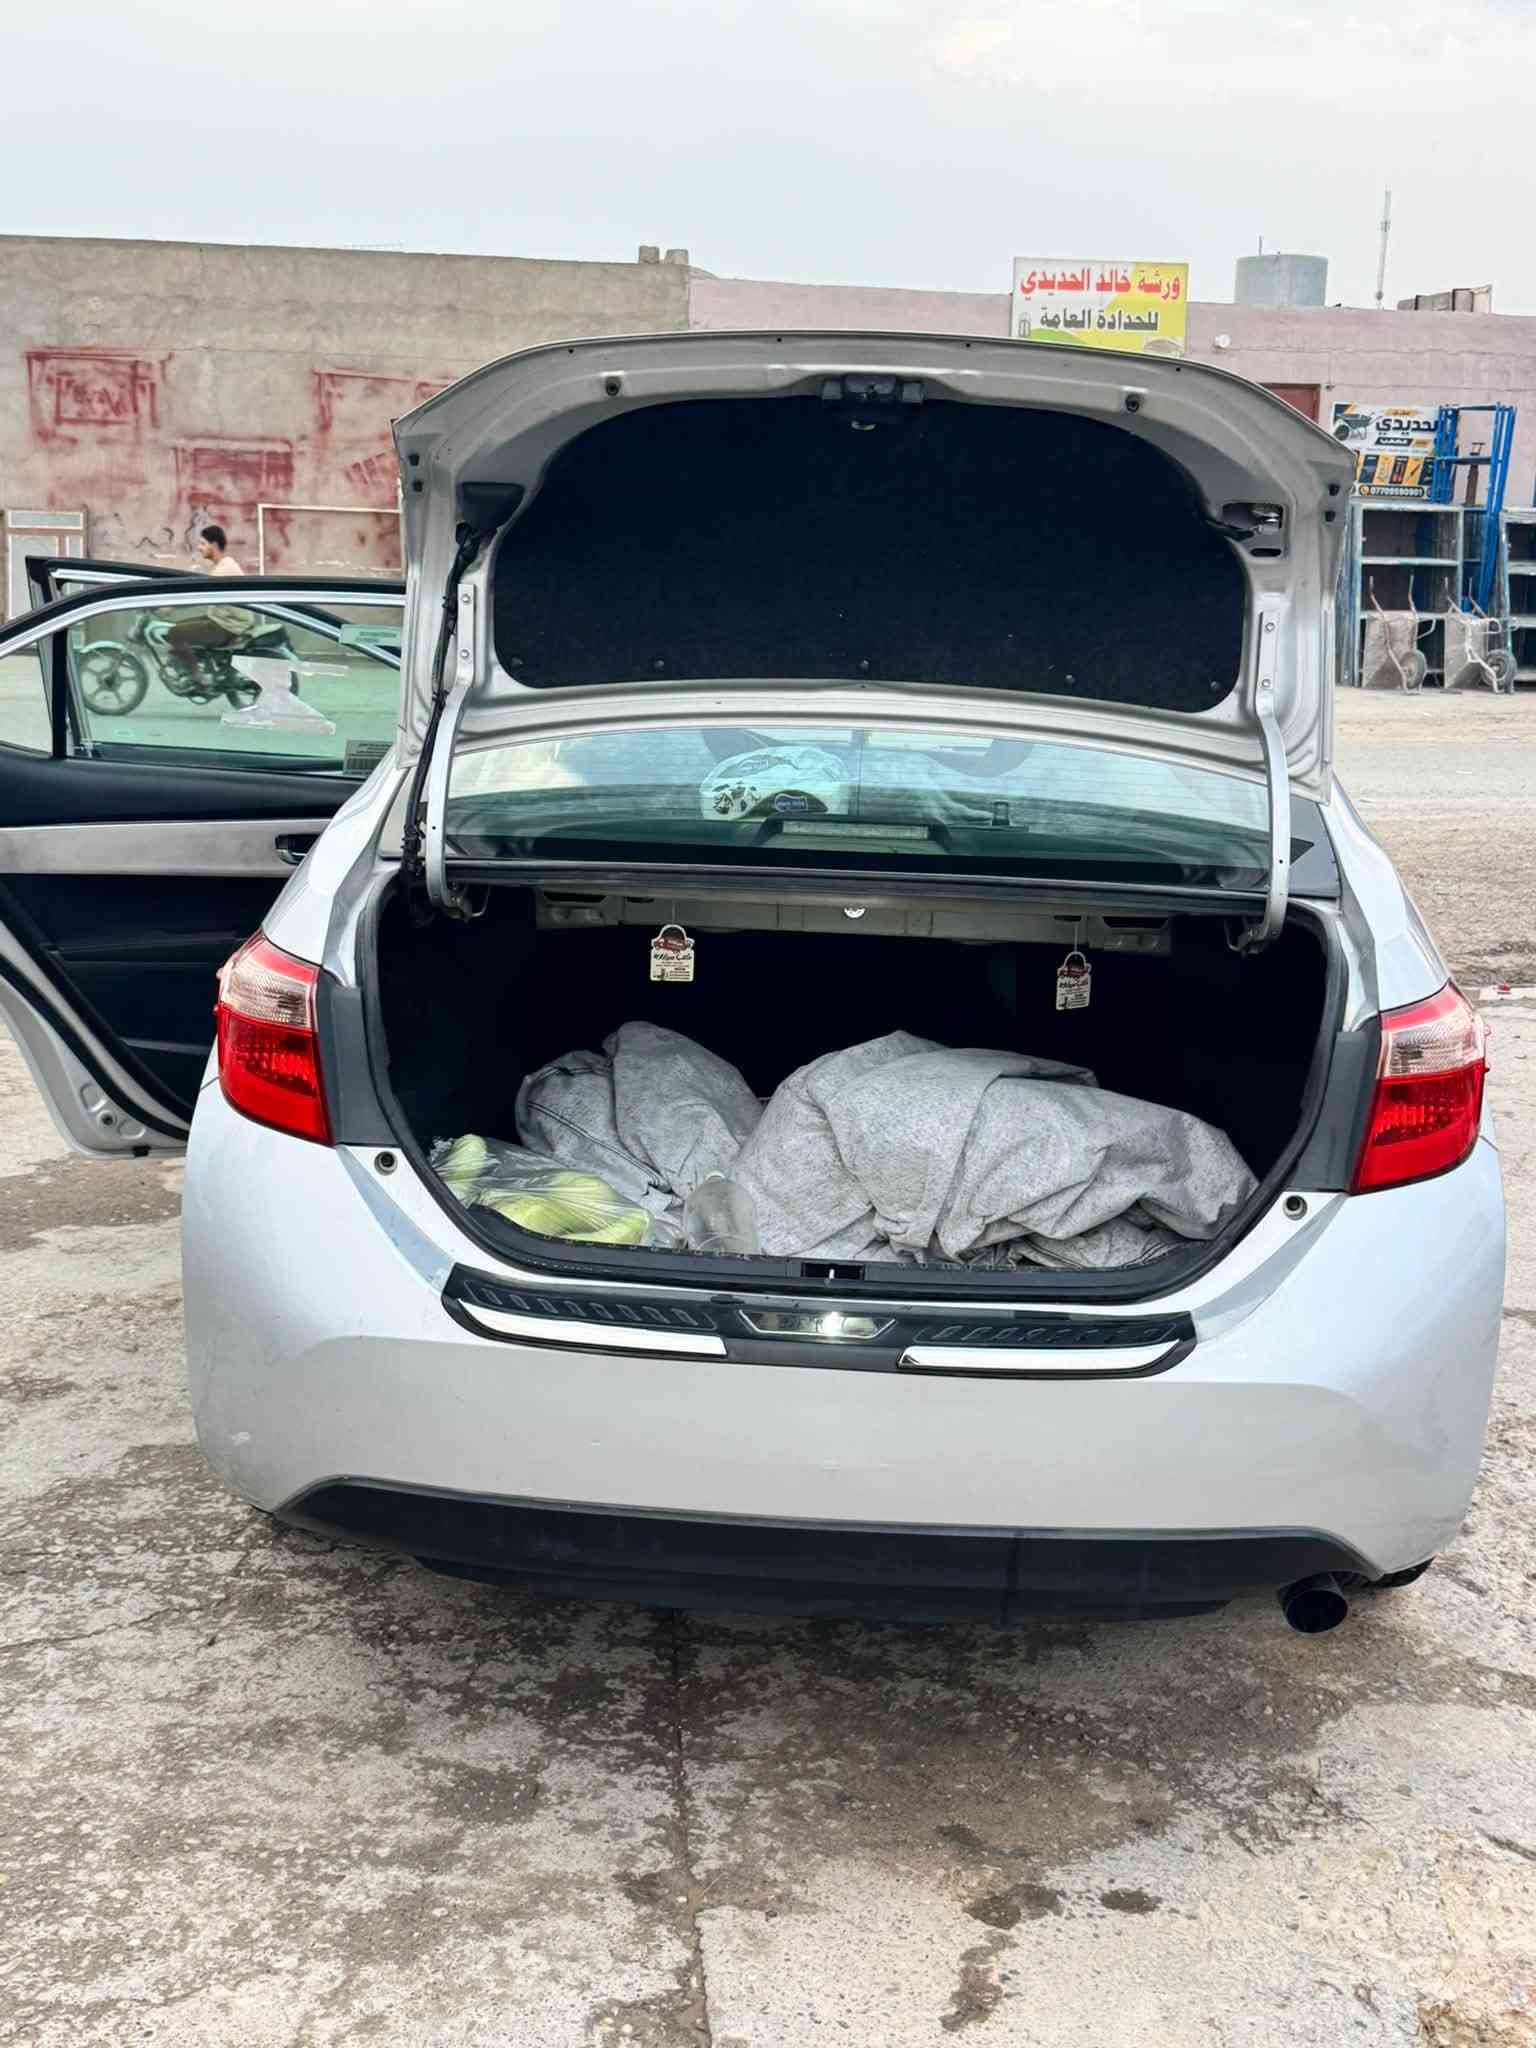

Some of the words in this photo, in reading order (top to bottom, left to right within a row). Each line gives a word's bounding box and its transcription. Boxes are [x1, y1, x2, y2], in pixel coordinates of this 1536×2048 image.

[1020, 268, 1091, 300] الحديدي
[1095, 267, 1131, 293] خالد
[1138, 270, 1180, 299] ورشة
[1040, 307, 1091, 329] العامة
[1097, 304, 1158, 331] للحدادة
[1376, 418, 1439, 435] لحديدي
